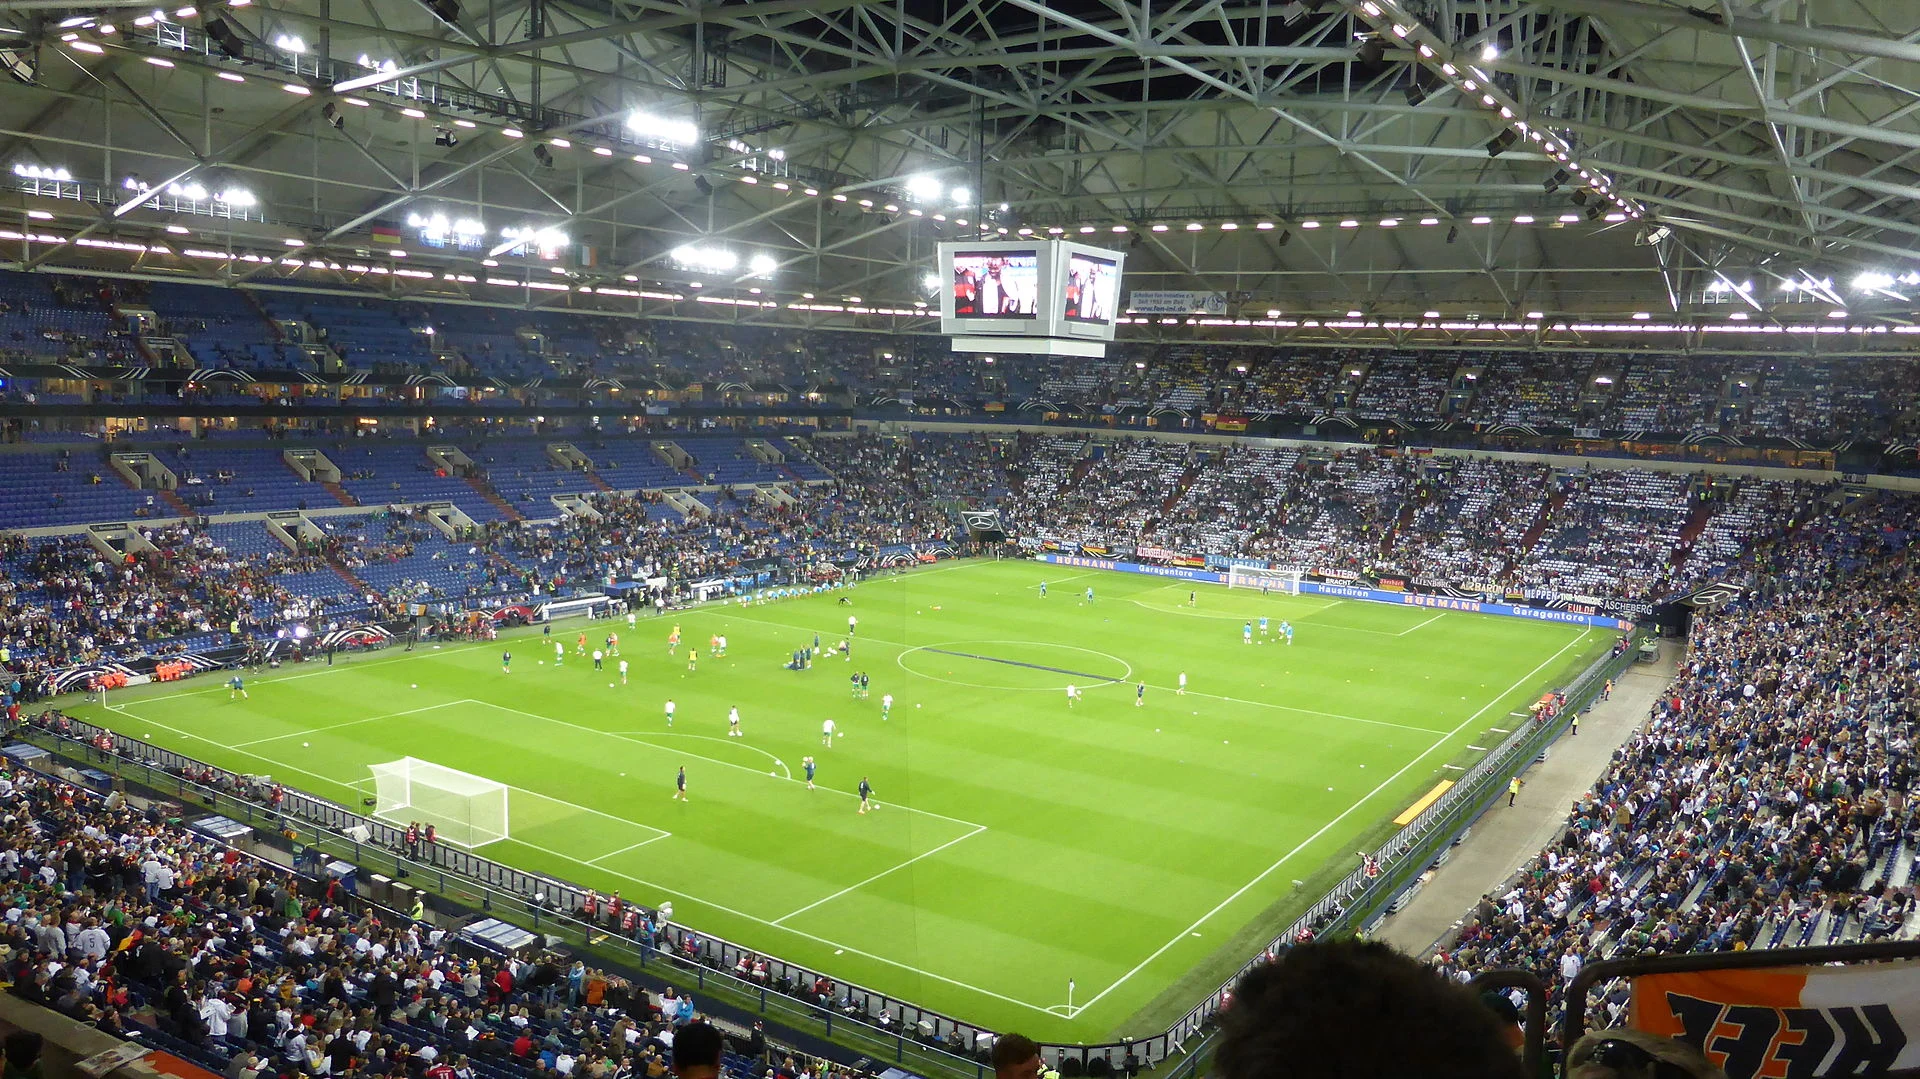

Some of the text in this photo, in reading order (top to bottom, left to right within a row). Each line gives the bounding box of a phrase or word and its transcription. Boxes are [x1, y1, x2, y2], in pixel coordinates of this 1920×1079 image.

[1139, 565, 1193, 577] Garagentore
[1325, 578, 1351, 586] BRACHT
[1318, 585, 1369, 597] Haustüren
[1524, 589, 1558, 600] MEPPEN
[1604, 600, 1653, 615] ASCHEBERG
[1513, 606, 1584, 622] Garagentore
[89, 938, 95, 948] 5
